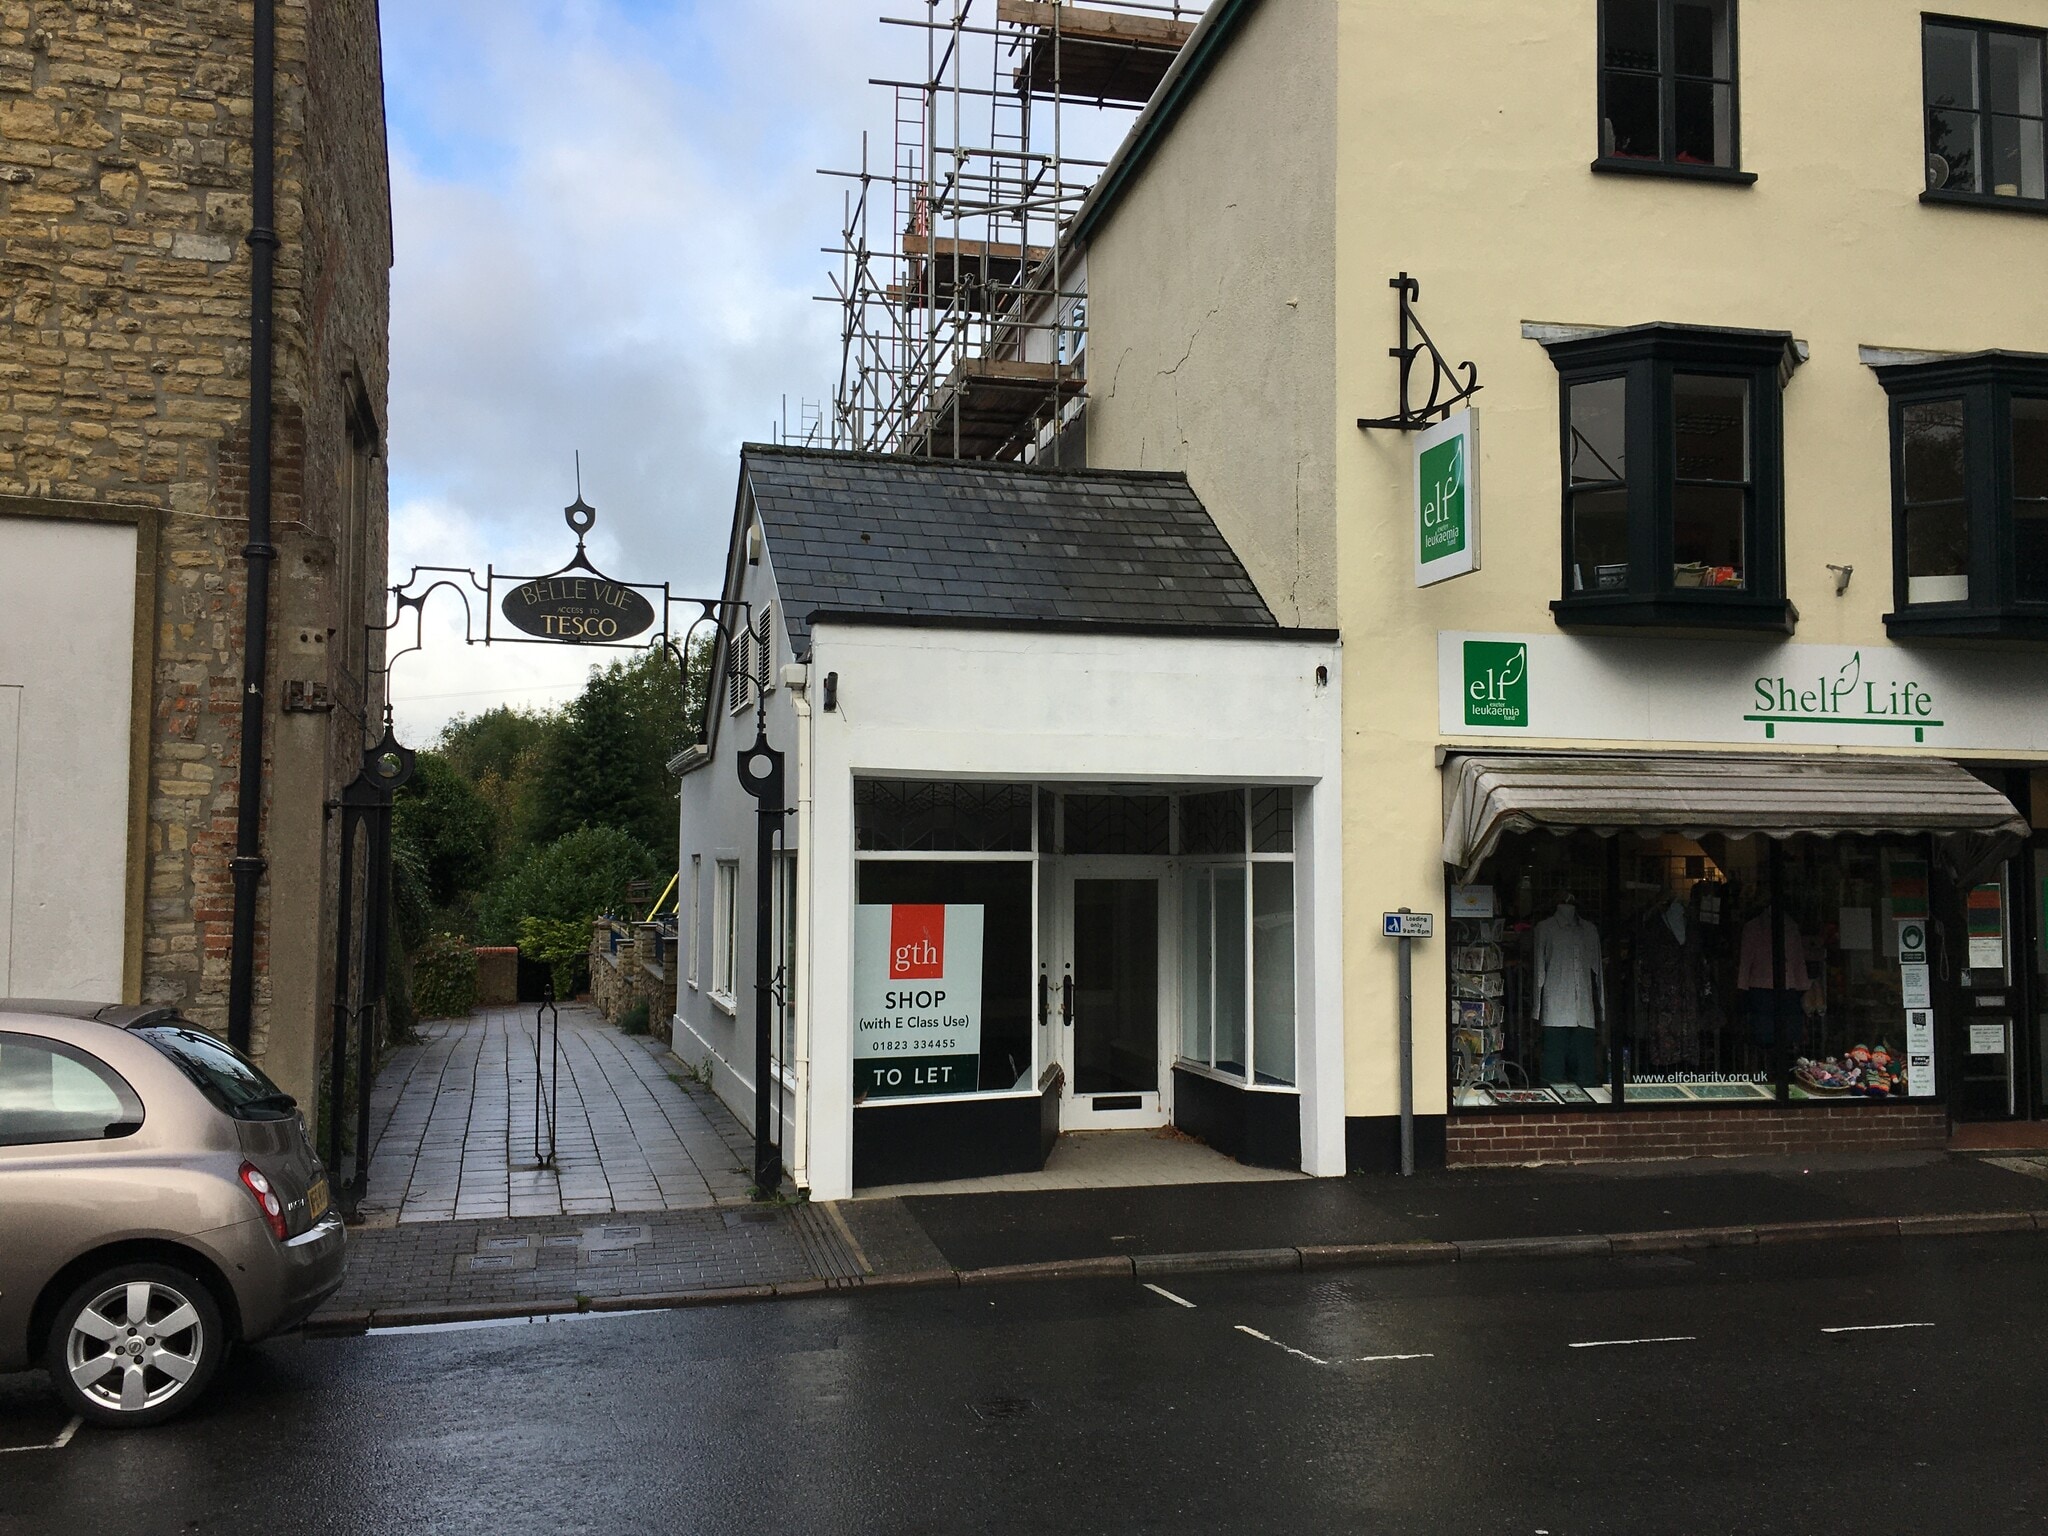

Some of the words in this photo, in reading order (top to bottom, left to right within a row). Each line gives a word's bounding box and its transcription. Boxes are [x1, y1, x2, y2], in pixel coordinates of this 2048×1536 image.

[1424, 439, 1462, 528] elf
[1425, 525, 1459, 548] leukaemia
[520, 579, 587, 606] BELLE
[593, 581, 634, 611] VUE
[557, 606, 584, 615] ACCESS
[540, 614, 617, 637] TESCO
[1470, 646, 1525, 701] elf
[1754, 650, 1861, 713] Shelf
[1863, 681, 1933, 716] Life
[1472, 704, 1520, 716] leukaemia
[895, 939, 938, 972] gth
[885, 990, 946, 1009] SHOP
[859, 1017, 891, 1032] (with
[895, 1017, 904, 1029] E
[907, 1016, 939, 1029] Class
[943, 1015, 970, 1029] Use)
[872, 1041, 908, 1051] 01823
[913, 1039, 956, 1049] 334455
[873, 1068, 902, 1086] TO
[914, 1066, 953, 1084] LET
[1632, 1071, 1768, 1083] www.elfcharity.org.uk
